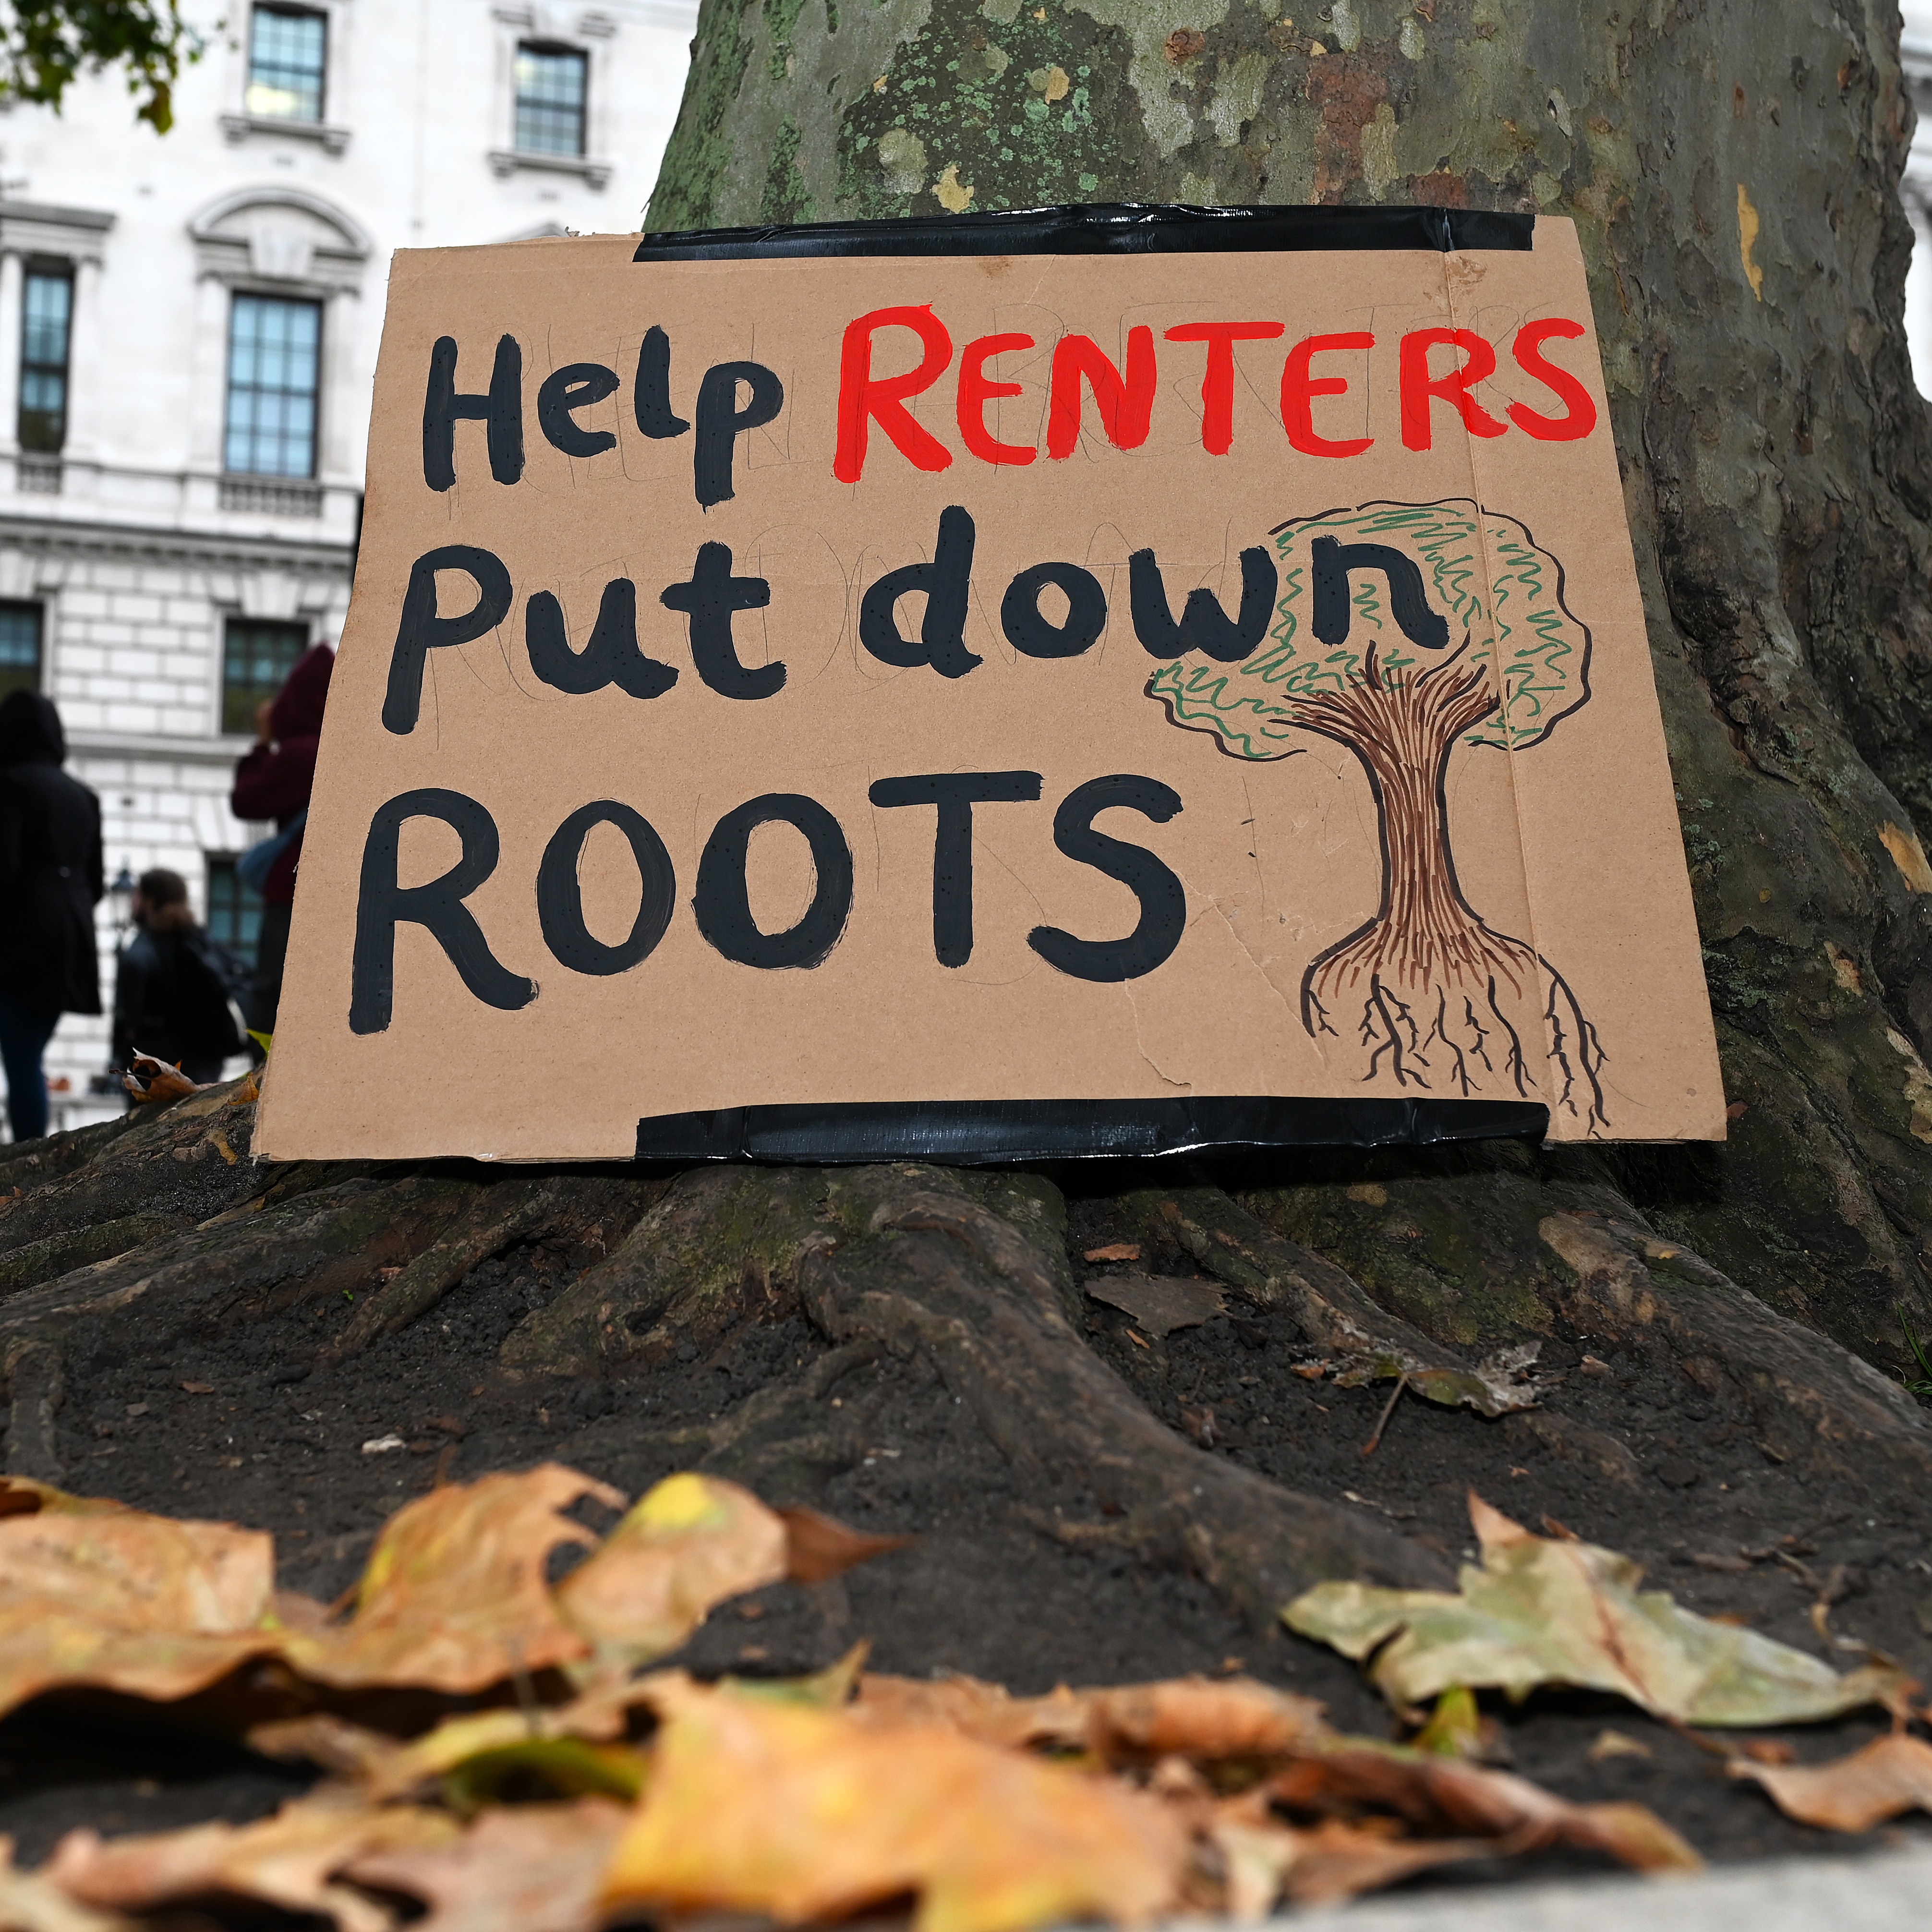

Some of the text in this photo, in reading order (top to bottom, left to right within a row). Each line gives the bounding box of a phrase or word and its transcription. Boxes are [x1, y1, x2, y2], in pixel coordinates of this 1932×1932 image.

[423, 304, 1597, 514] Help RENTERS
[859, 505, 1449, 678] down
[349, 770, 1186, 1036] ROOTS
